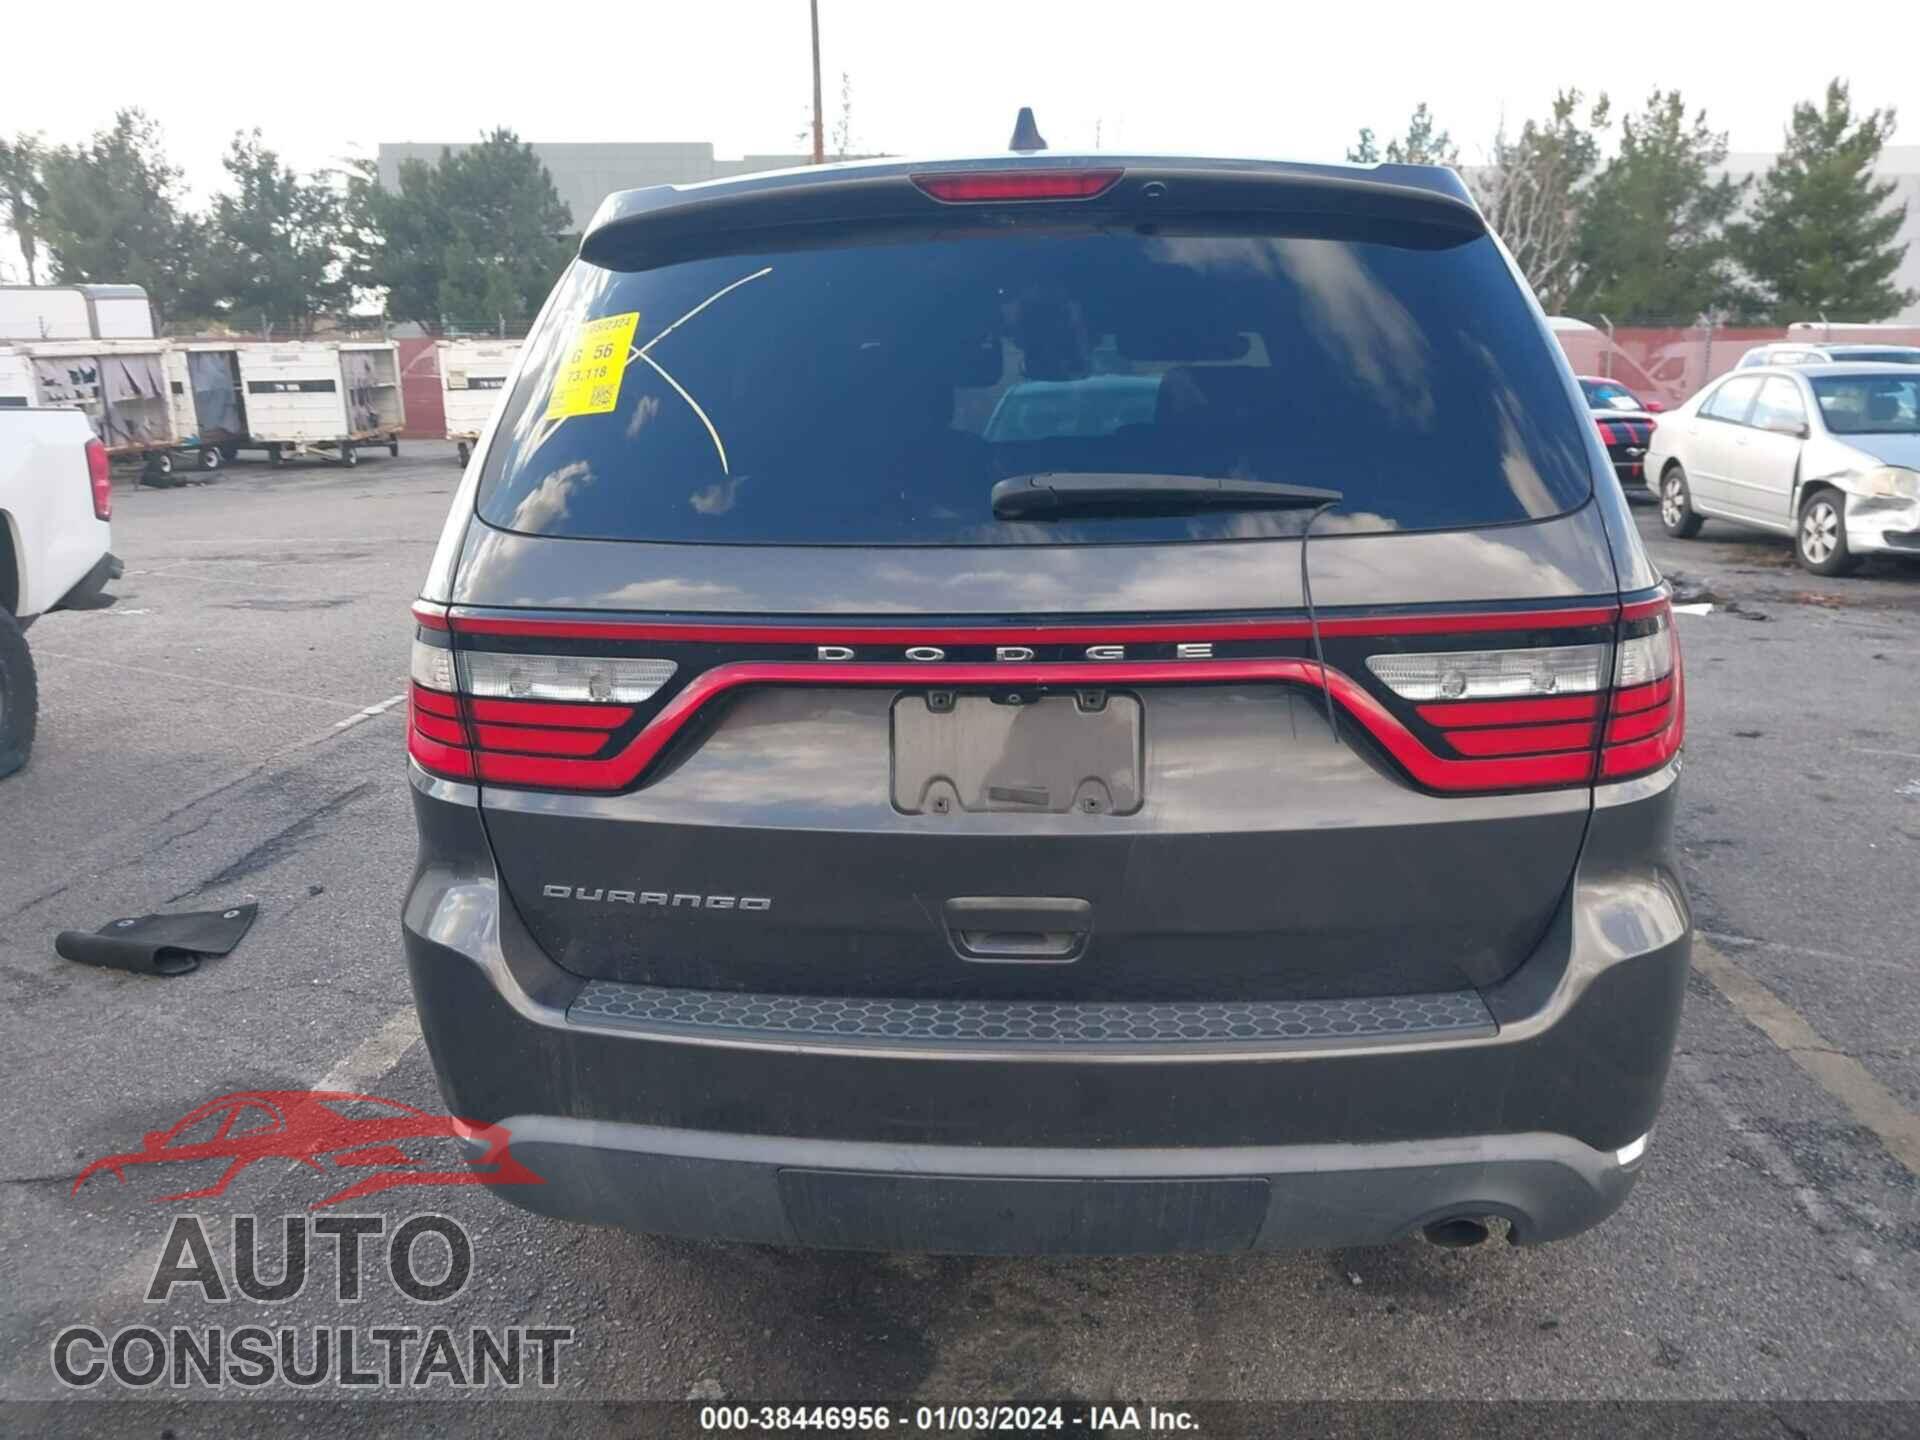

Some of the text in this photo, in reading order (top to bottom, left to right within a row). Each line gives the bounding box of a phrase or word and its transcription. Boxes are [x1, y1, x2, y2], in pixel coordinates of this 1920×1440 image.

[593, 342, 614, 360] 56
[817, 643, 1214, 662] DODGE
[543, 884, 772, 911] DURANGO
